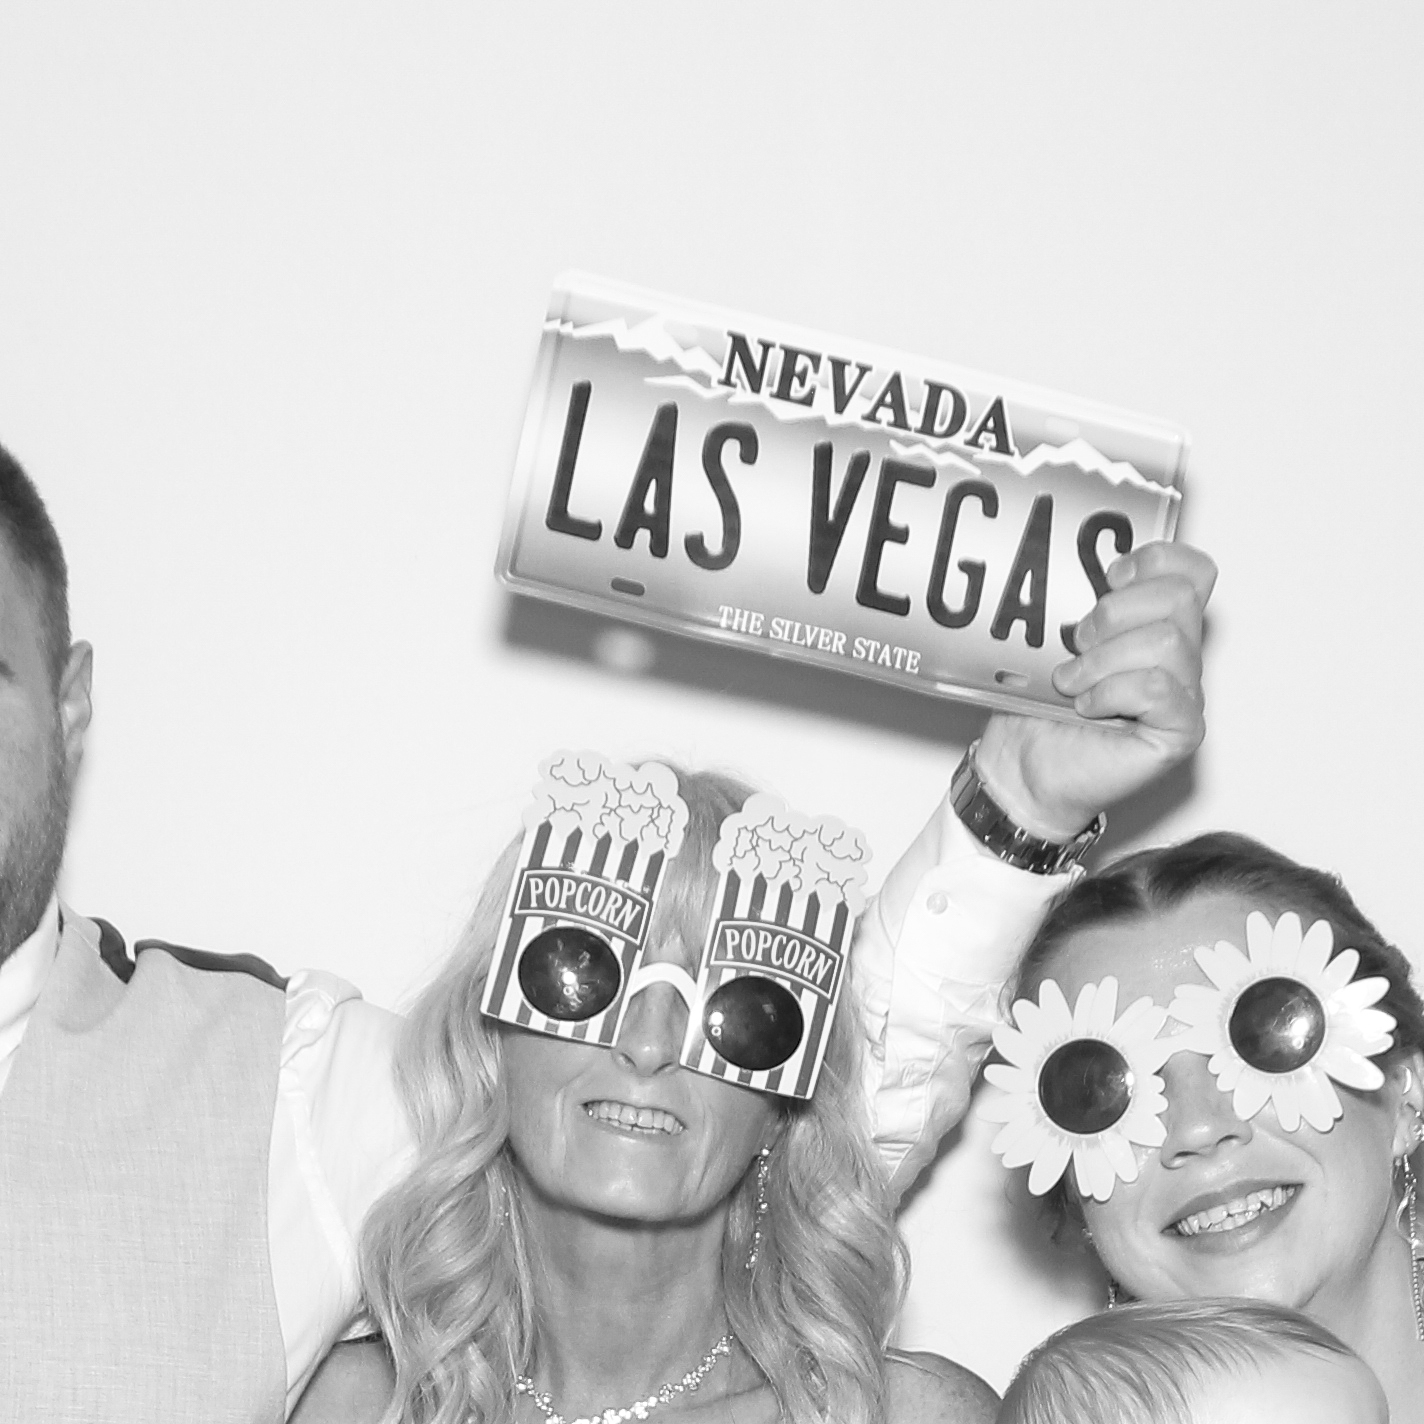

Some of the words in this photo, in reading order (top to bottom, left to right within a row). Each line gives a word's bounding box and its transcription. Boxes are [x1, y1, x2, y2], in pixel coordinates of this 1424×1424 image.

[717, 329, 1016, 456] NEVADA
[544, 379, 759, 571] LAS
[806, 440, 1134, 656] VEGAS
[717, 604, 764, 636] THE
[769, 616, 848, 656] SILVER
[852, 636, 923, 675] STATE
[528, 875, 642, 932] POPCORN
[724, 927, 834, 986] POPCORN
